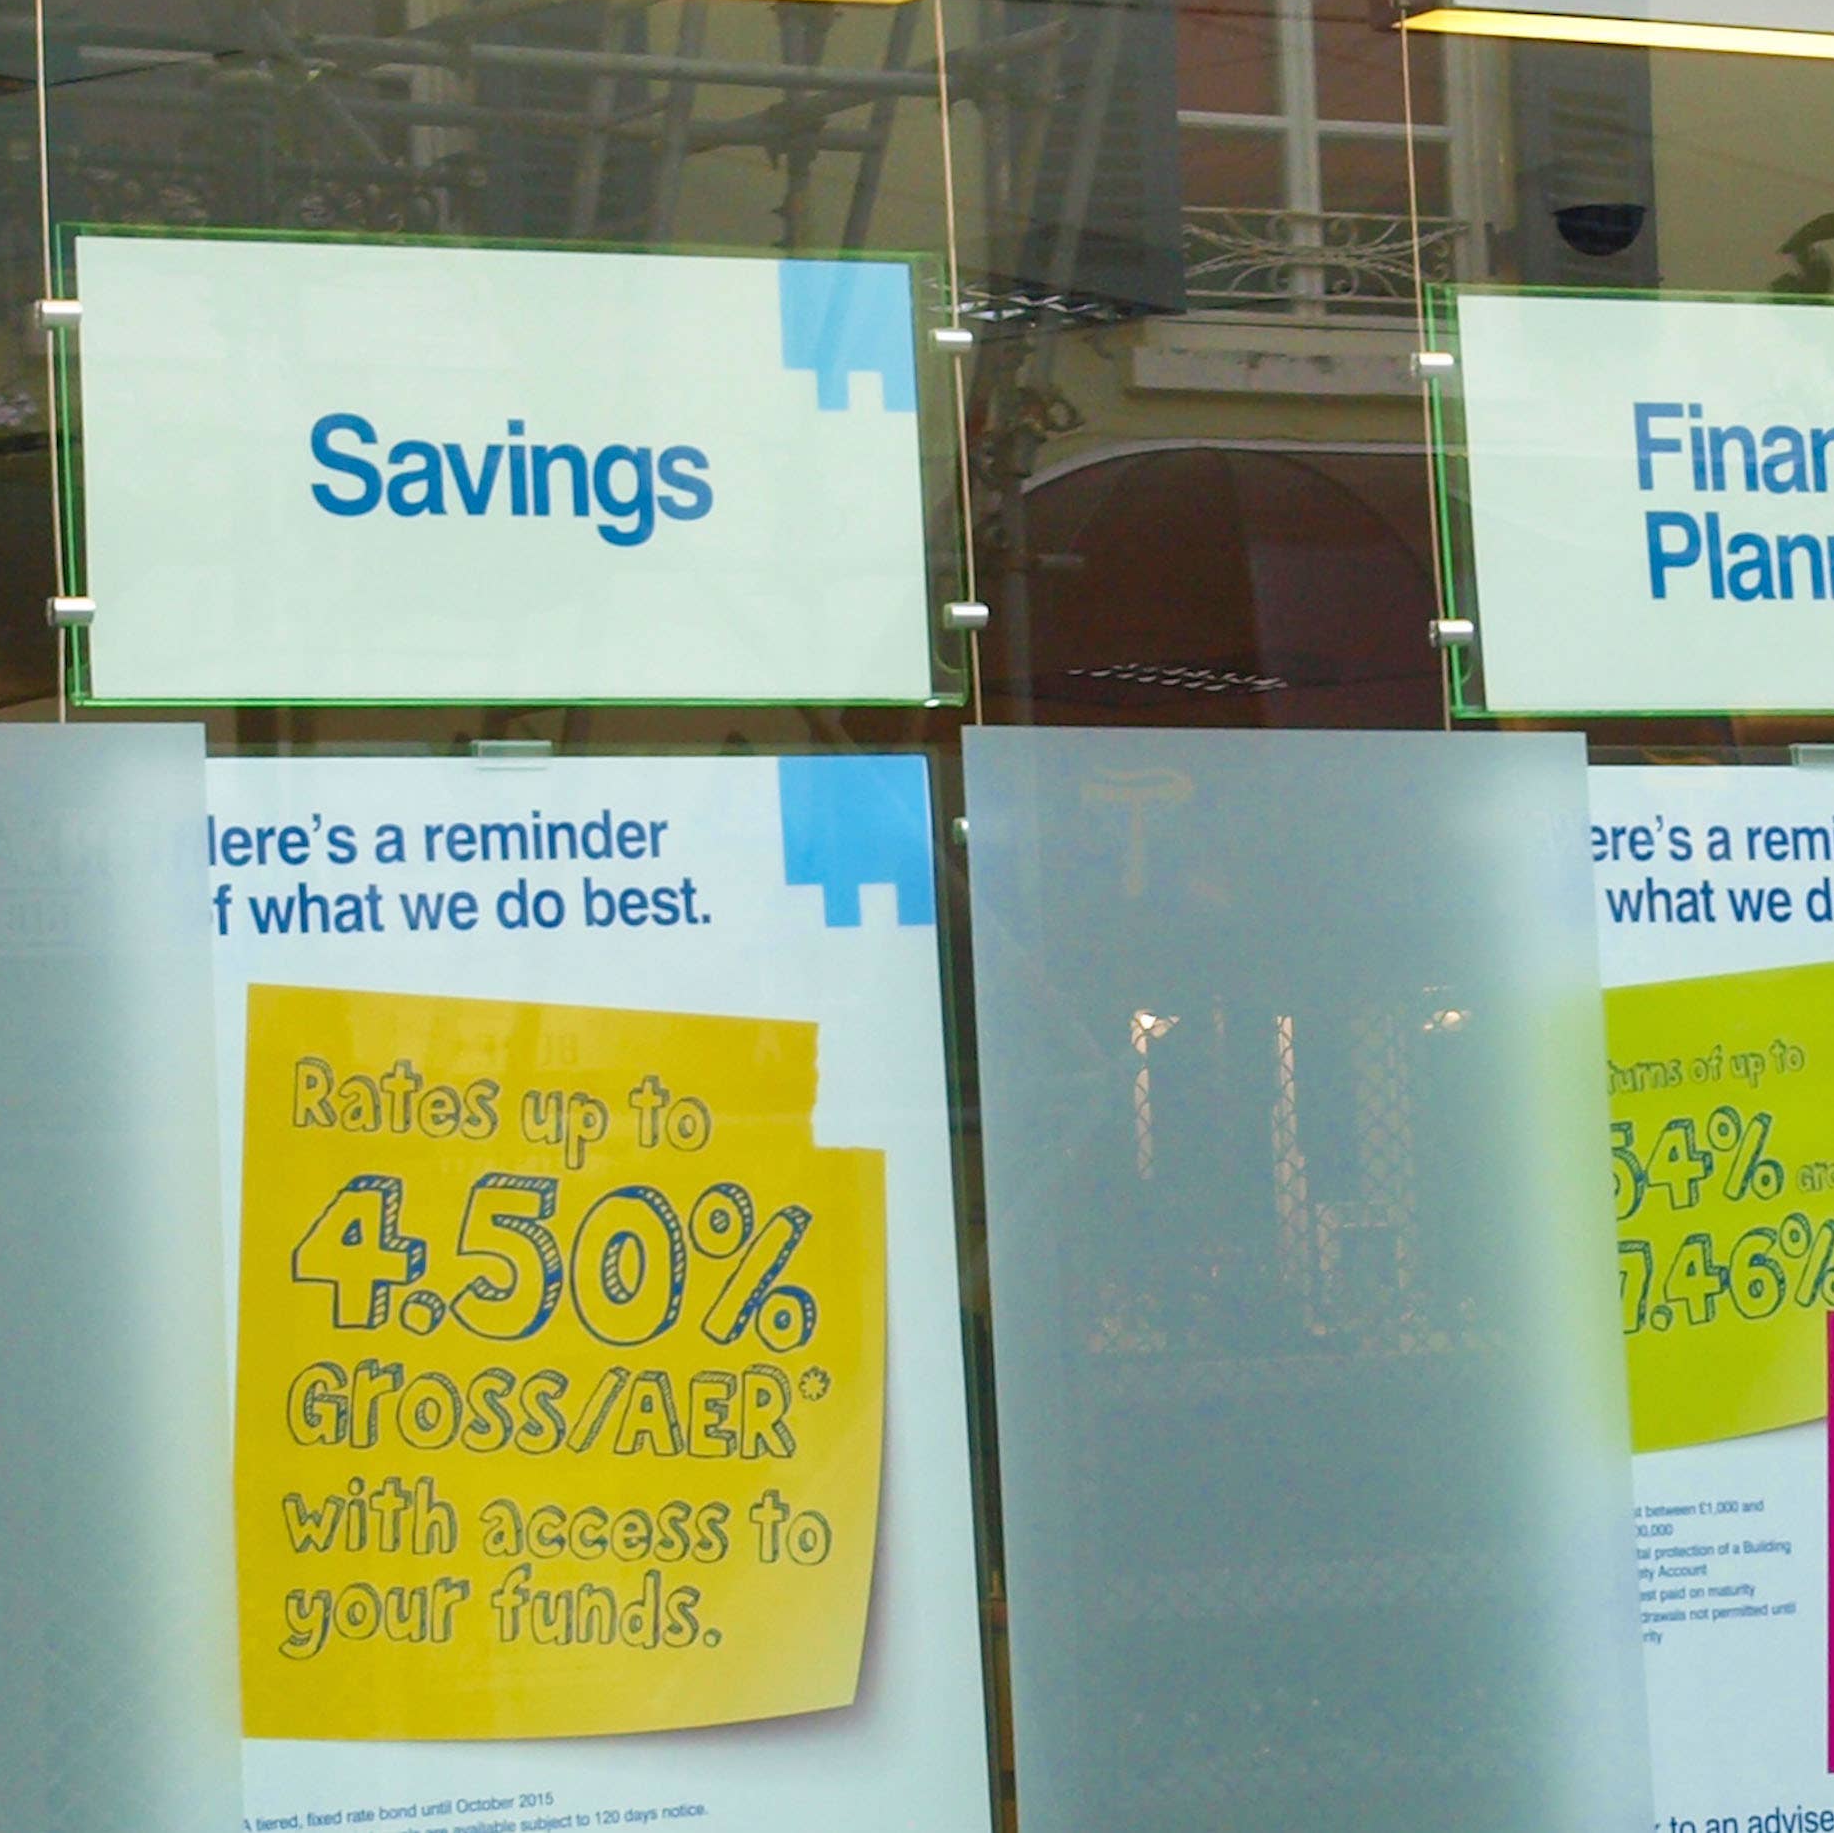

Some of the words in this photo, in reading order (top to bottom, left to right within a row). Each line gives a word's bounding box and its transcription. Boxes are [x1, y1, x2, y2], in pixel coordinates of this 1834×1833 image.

[310, 412, 713, 546] Savings
[374, 822, 407, 864] a
[424, 810, 668, 864] reminder
[1590, 814, 1694, 863] ere's
[1706, 824, 1733, 862] a
[247, 881, 385, 935] what
[398, 890, 479, 932] we
[495, 878, 566, 930] do
[583, 875, 713, 929] best.
[1605, 876, 1717, 924] what
[1727, 886, 1793, 924] we
[1690, 1043, 1724, 1084] of
[1731, 1050, 1767, 1089] up
[1770, 1037, 1807, 1074] to
[291, 1055, 500, 1139] Rates
[519, 1086, 609, 1170] up
[629, 1073, 712, 1152] to
[291, 1174, 819, 1352] 4.50%
[280, 1475, 457, 1558] with
[480, 1498, 730, 1563] access
[751, 1488, 832, 1566] to
[1645, 1503, 1696, 1517] between
[1742, 1499, 1765, 1513] and
[1654, 1544, 1715, 1561] protection
[1717, 1542, 1731, 1555] of
[1732, 1544, 1741, 1555] a
[1743, 1539, 1793, 1555] Building
[1658, 1563, 1708, 1578] Account
[279, 1574, 470, 1660] your
[491, 1564, 724, 1652] funds.
[1640, 1609, 1686, 1624] drawals
[1689, 1607, 1709, 1621] not
[1712, 1603, 1769, 1622] permitted
[1771, 1601, 1798, 1616] until
[1660, 1586, 1686, 1603] paid
[1689, 1587, 1706, 1598] on
[1708, 1582, 1756, 1601] maturity
[256, 1813, 302, 1833] tiered,
[306, 1811, 343, 1828] fixed
[345, 1808, 375, 1824] rate
[378, 1803, 418, 1821] bond
[420, 1799, 453, 1816] until
[456, 1795, 515, 1814] October
[518, 1791, 555, 1809] 2015
[520, 1814, 573, 1833] subject
[576, 1812, 591, 1827] to
[595, 1810, 621, 1825] 120
[624, 1807, 659, 1825] days
[1670, 1814, 1698, 1833] to
[1705, 1814, 1739, 1833] an
